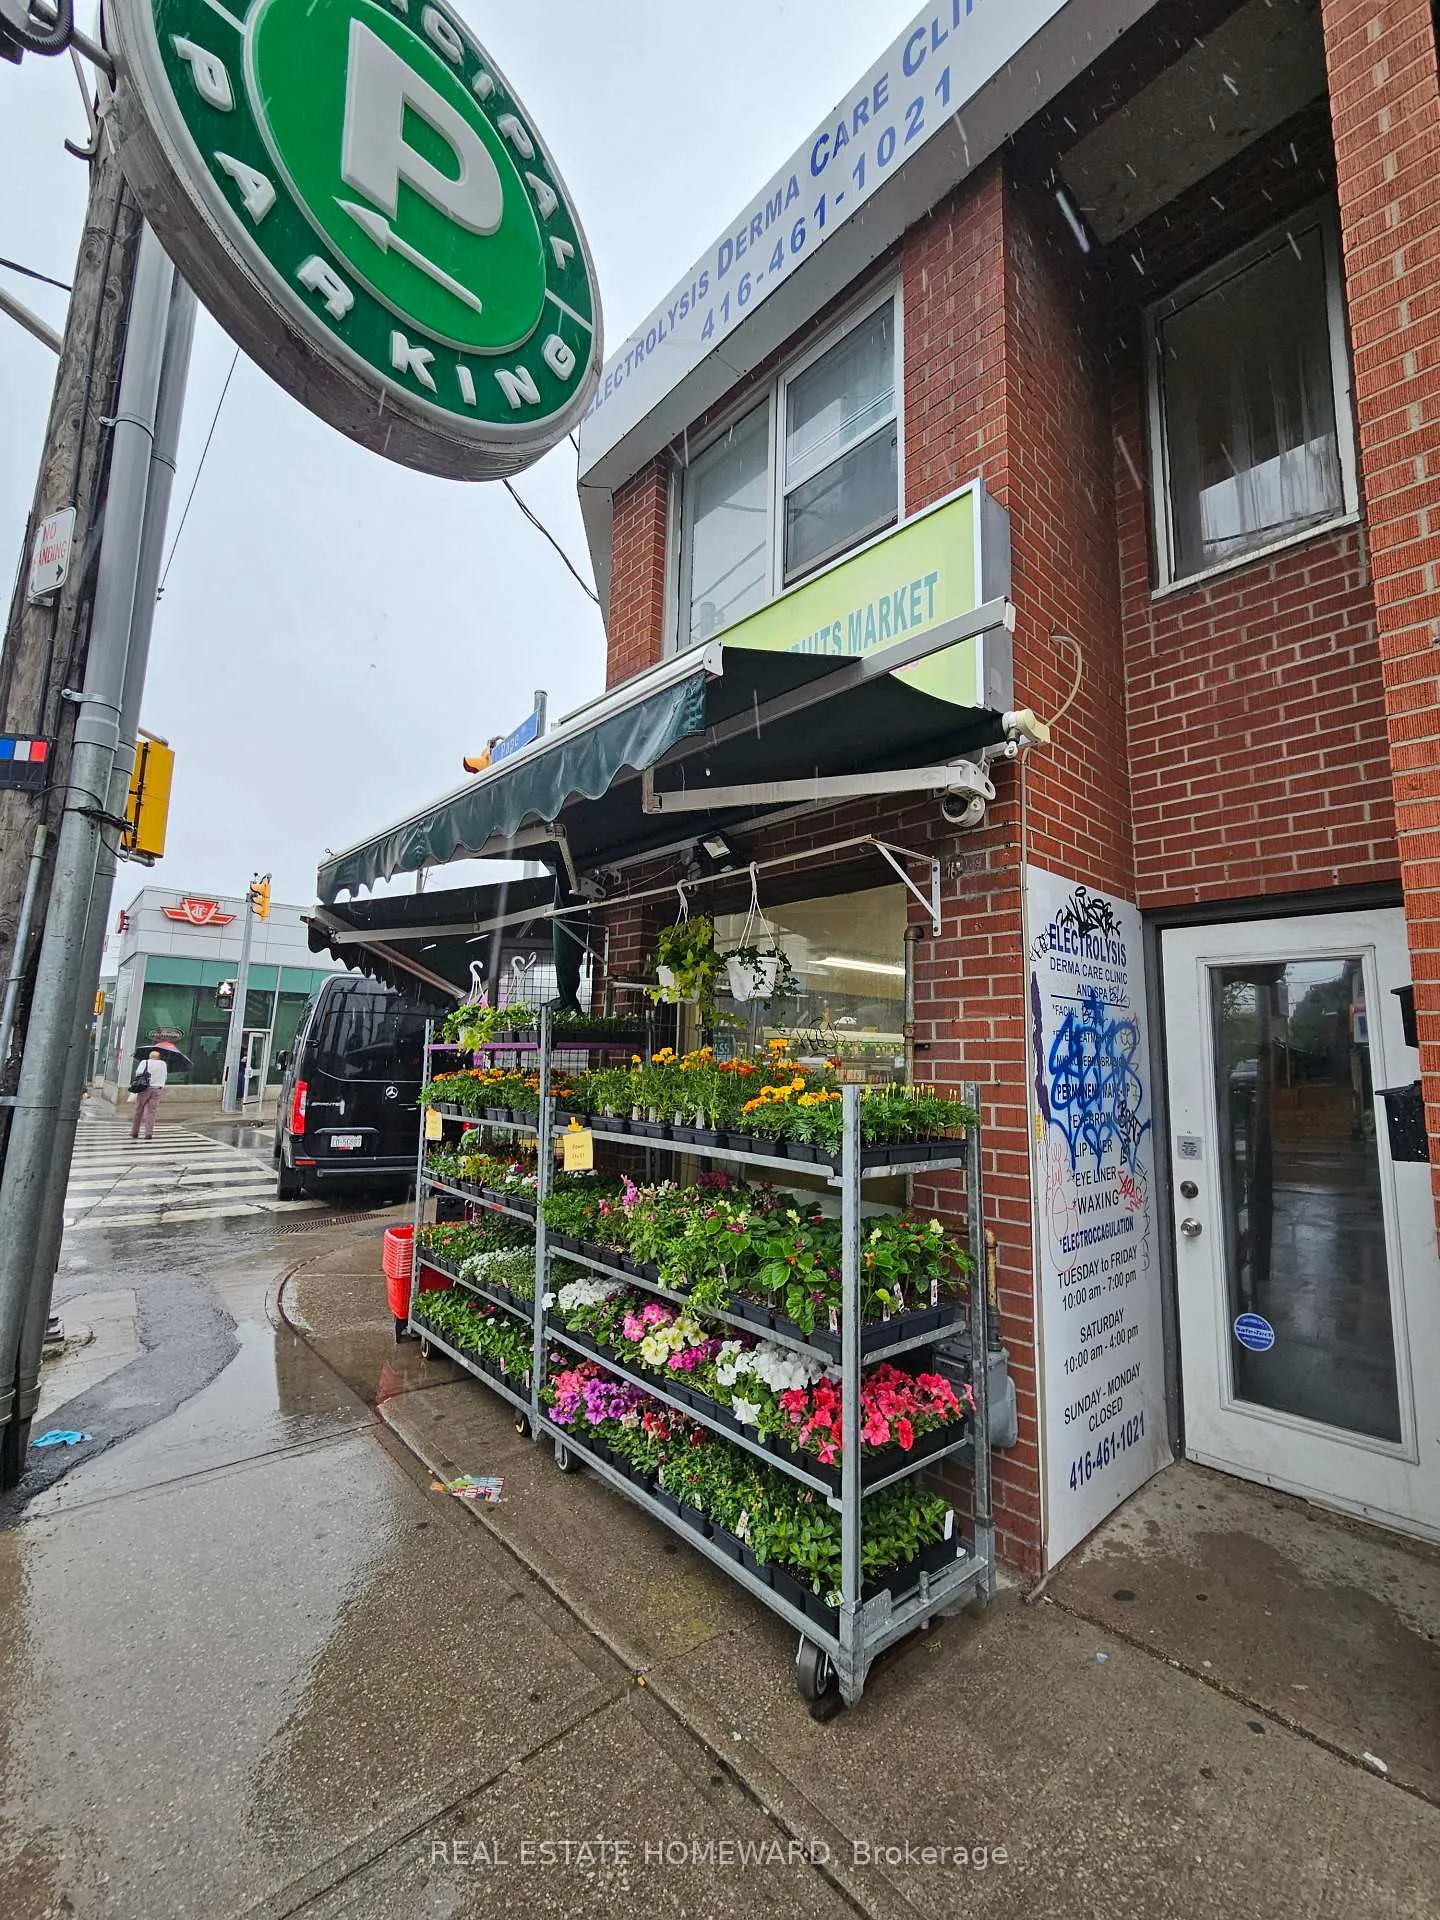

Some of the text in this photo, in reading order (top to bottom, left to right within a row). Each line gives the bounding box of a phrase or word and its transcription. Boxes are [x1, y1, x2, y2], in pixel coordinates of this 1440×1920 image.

[341, 17, 503, 237] P
[717, 174, 800, 280] DERMA
[810, 72, 889, 177] CARE
[172, 34, 577, 411] PARKING
[701, 65, 950, 342] 416-461-1021
[43, 521, 57, 541] NO
[847, 570, 939, 656] MARKET
[1049, 923, 1127, 967] ELECTROLYSIS
[1050, 956, 1128, 985] DERMA CARE CLINIC
[1076, 983, 1092, 997] AND
[1094, 985, 1108, 999] SPA
[1089, 1139, 1113, 1156] LNER
[1093, 1166, 1117, 1184] LINER
[1057, 1245, 1138, 1289] TUESDAY to FRIDAY
[1062, 1287, 1087, 1311] 10:00
[1088, 1286, 1102, 1299] am
[1107, 1272, 1124, 1291] 7:00
[1125, 1269, 1137, 1287] pm
[1080, 1307, 1124, 1343] SATURDAY
[1064, 1348, 1089, 1375] 10:00
[1090, 1344, 1103, 1361] am
[1109, 1328, 1126, 1350] 4:00
[1127, 1324, 1139, 1344] pm
[1064, 1386, 1103, 1425] SUNDAY
[1107, 1361, 1141, 1397] MONDAY
[1088, 1396, 1124, 1432] CLOSED
[1069, 1410, 1145, 1491] 416-461-1021
